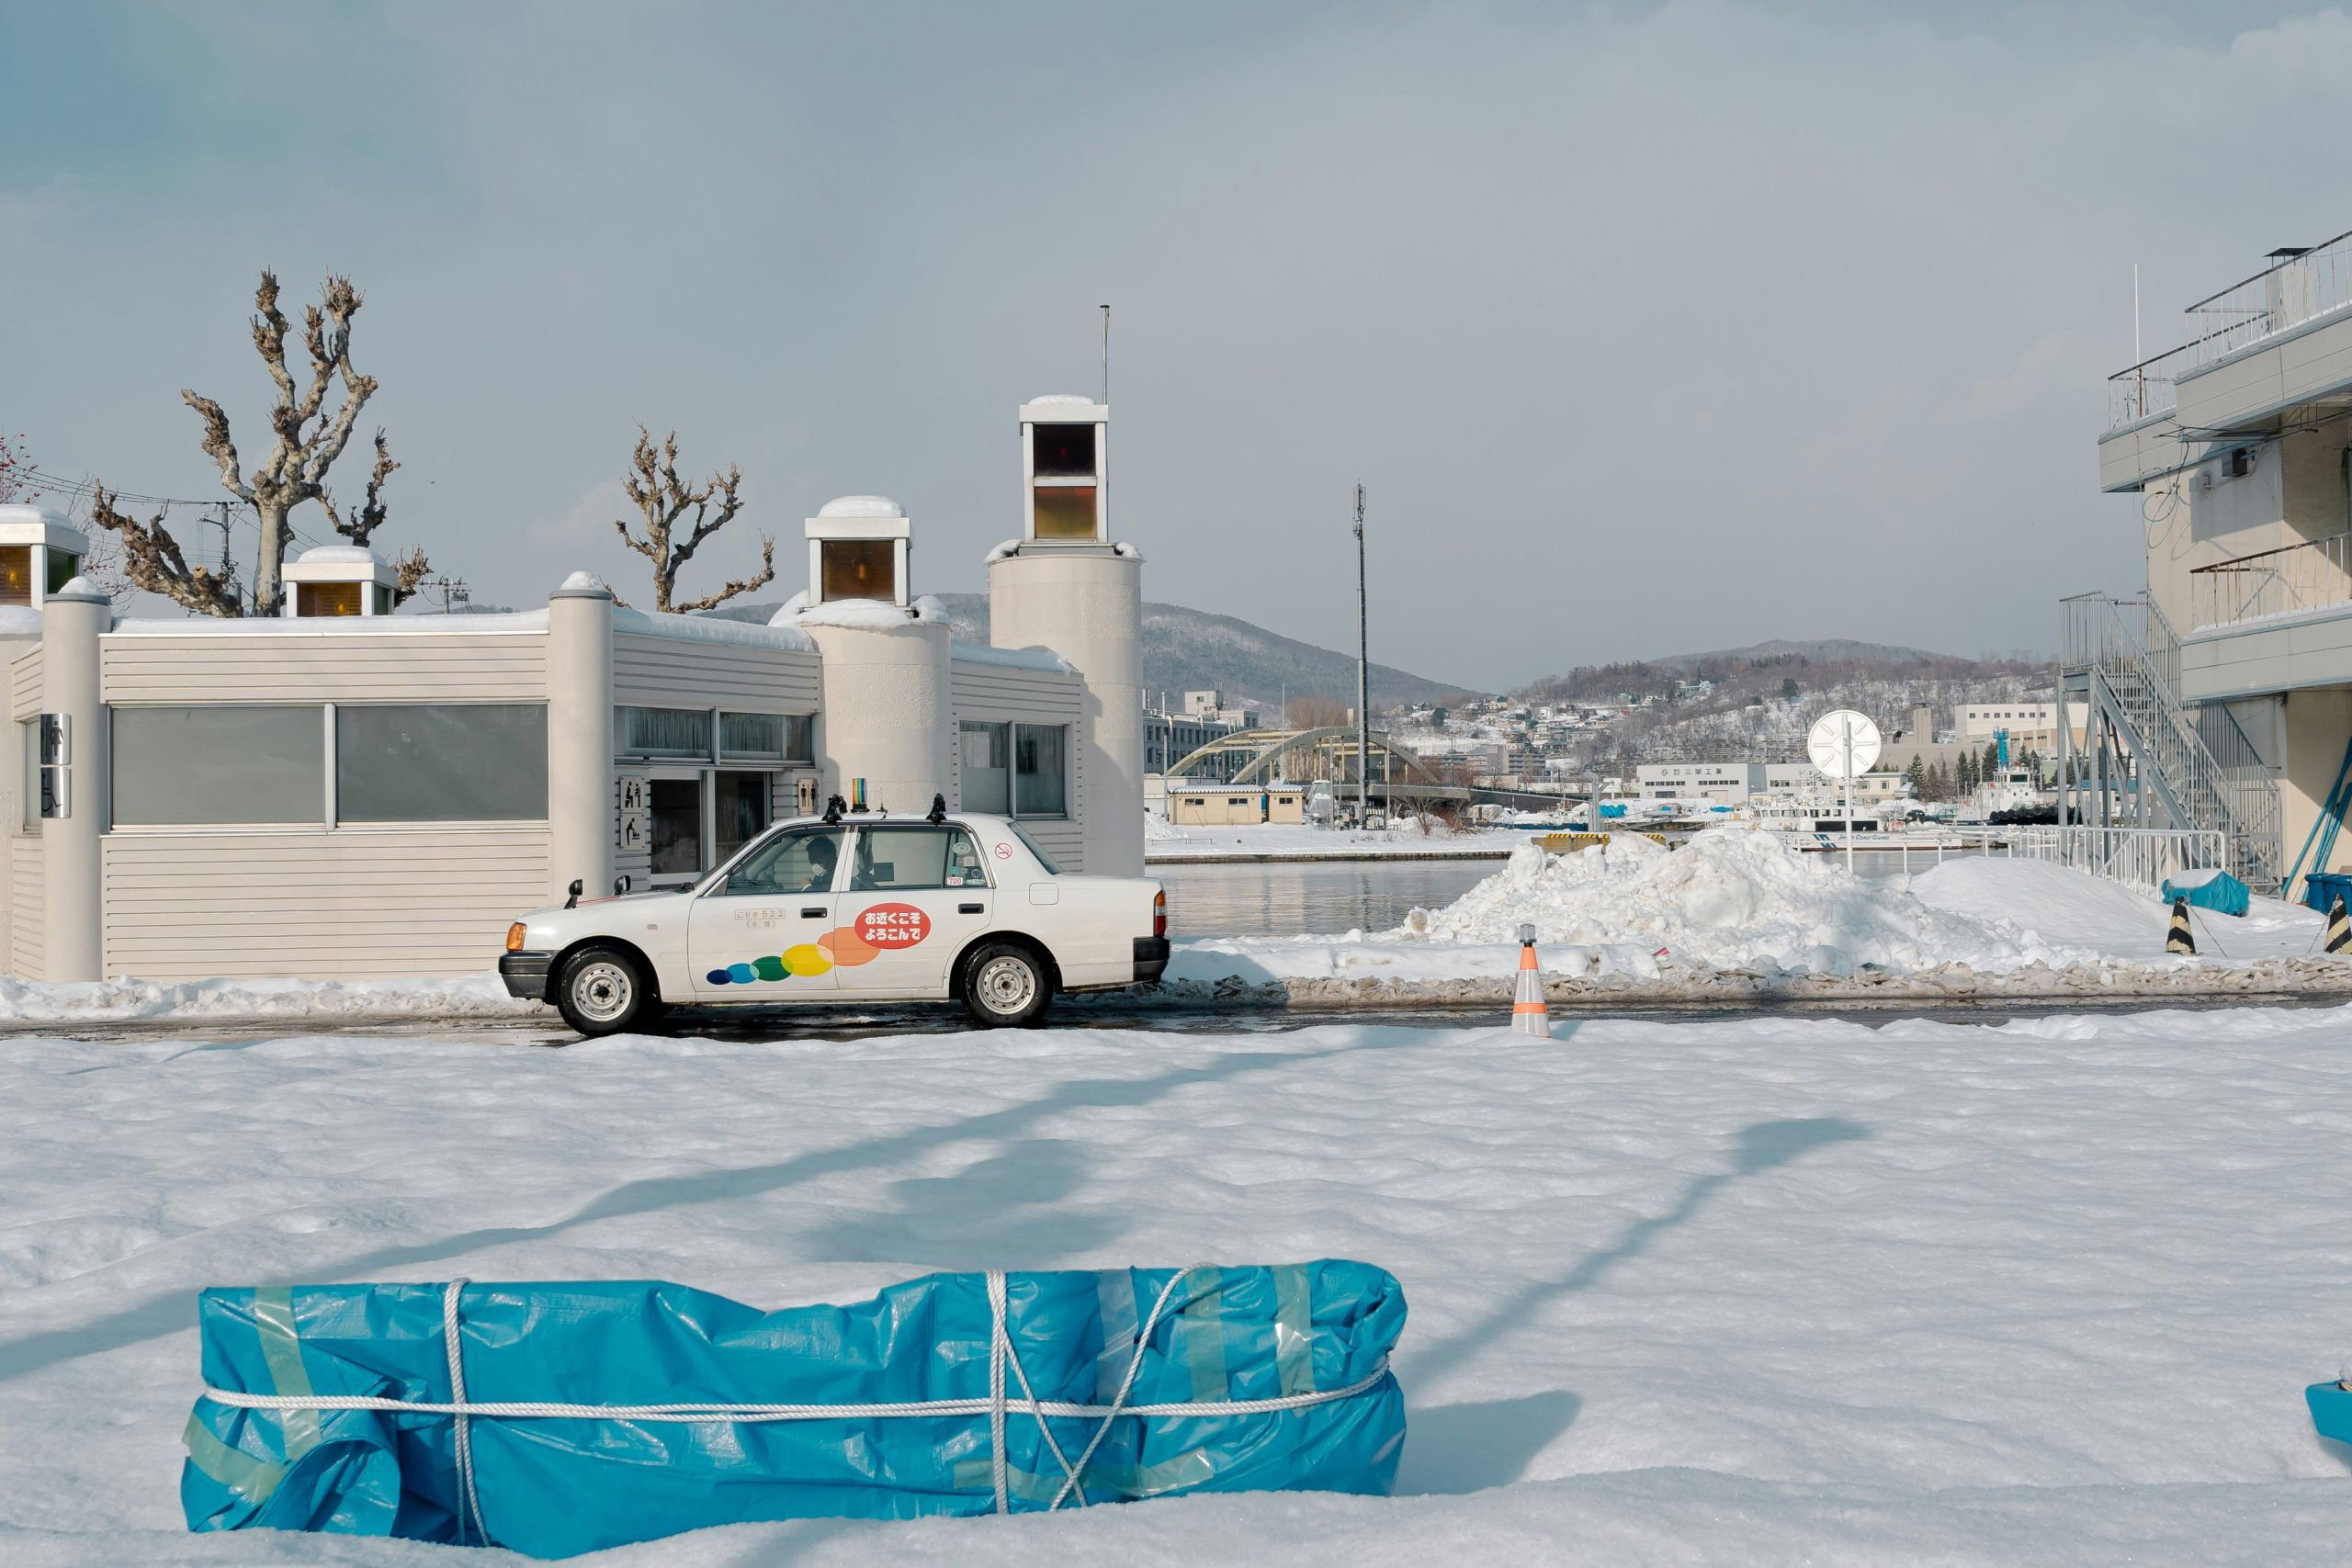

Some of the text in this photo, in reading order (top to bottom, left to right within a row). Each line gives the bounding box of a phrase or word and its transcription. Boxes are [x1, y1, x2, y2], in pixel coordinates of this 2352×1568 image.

[865, 912, 921, 925] お近くこそ
[865, 928, 921, 941] よろこんで
